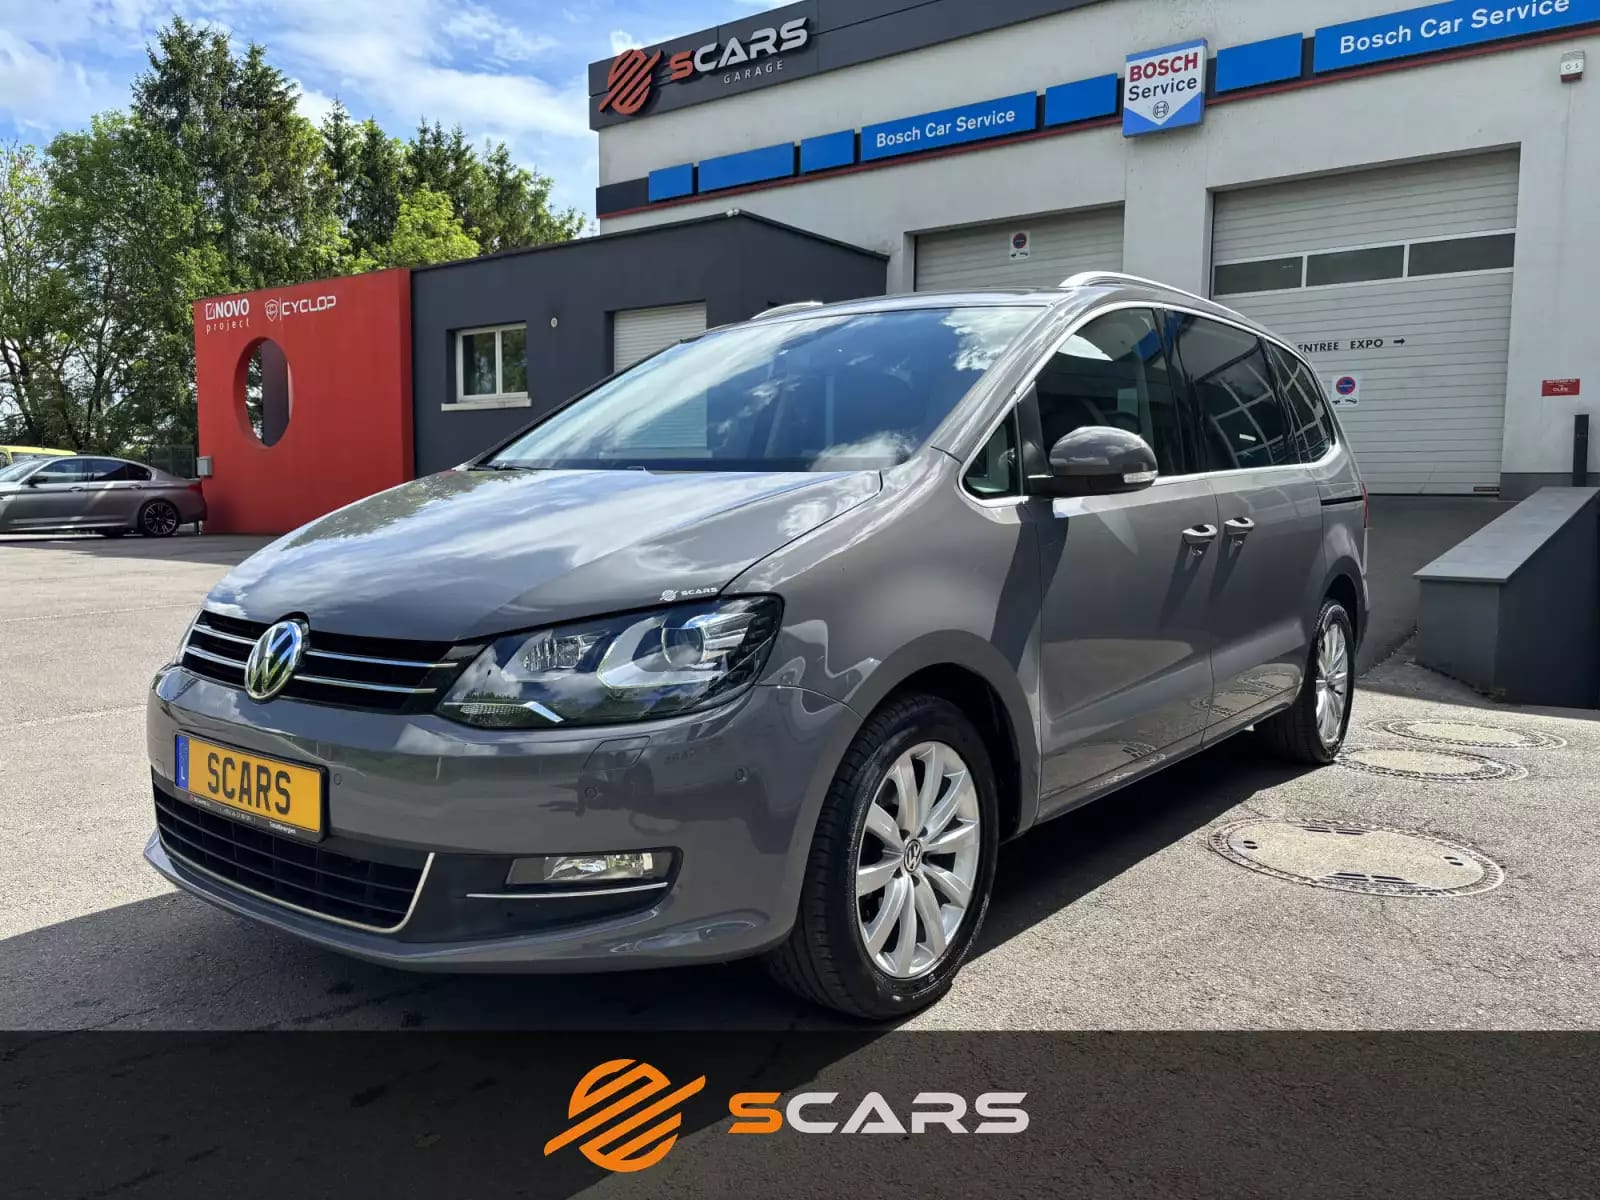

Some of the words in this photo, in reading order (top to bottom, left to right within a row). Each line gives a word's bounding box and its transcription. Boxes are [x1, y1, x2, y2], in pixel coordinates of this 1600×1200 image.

[1340, 26, 1411, 54] Bosch
[1420, 17, 1463, 40] Car
[1471, 0, 1570, 29] Service
[669, 17, 808, 81] SCARS
[723, 61, 784, 84] GARAGE
[1129, 52, 1199, 82] BOSCH
[1128, 77, 1197, 101] Service
[876, 126, 921, 148] Bosch
[925, 120, 953, 138] Car
[956, 109, 1016, 132] Service
[282, 296, 336, 315] CYCLOP
[206, 318, 250, 335] project
[1350, 339, 1384, 349] EXPO
[681, 587, 718, 595] SCARS
[207, 752, 291, 814] SCARS
